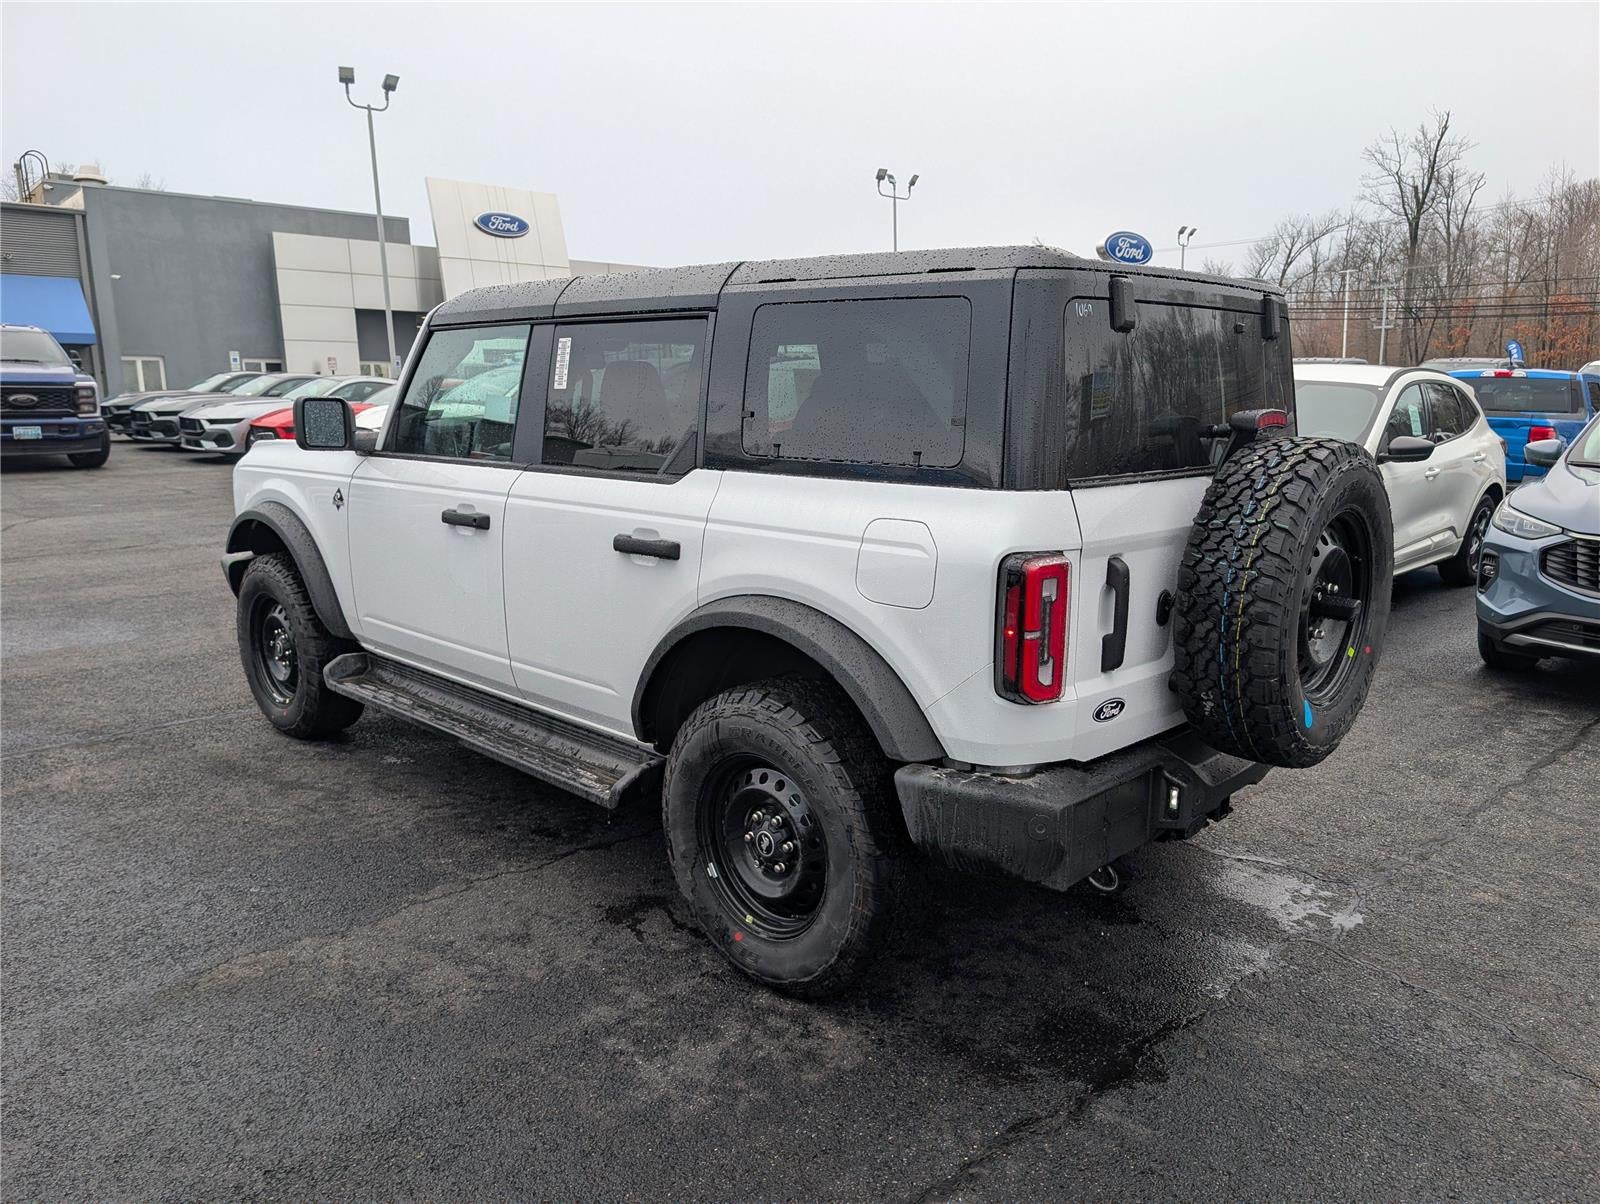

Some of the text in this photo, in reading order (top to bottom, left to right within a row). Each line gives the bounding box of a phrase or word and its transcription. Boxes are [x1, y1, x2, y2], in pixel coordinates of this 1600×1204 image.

[488, 215, 519, 232] Ford
[1115, 236, 1145, 260] Ford
[1100, 702, 1121, 719] Ford
